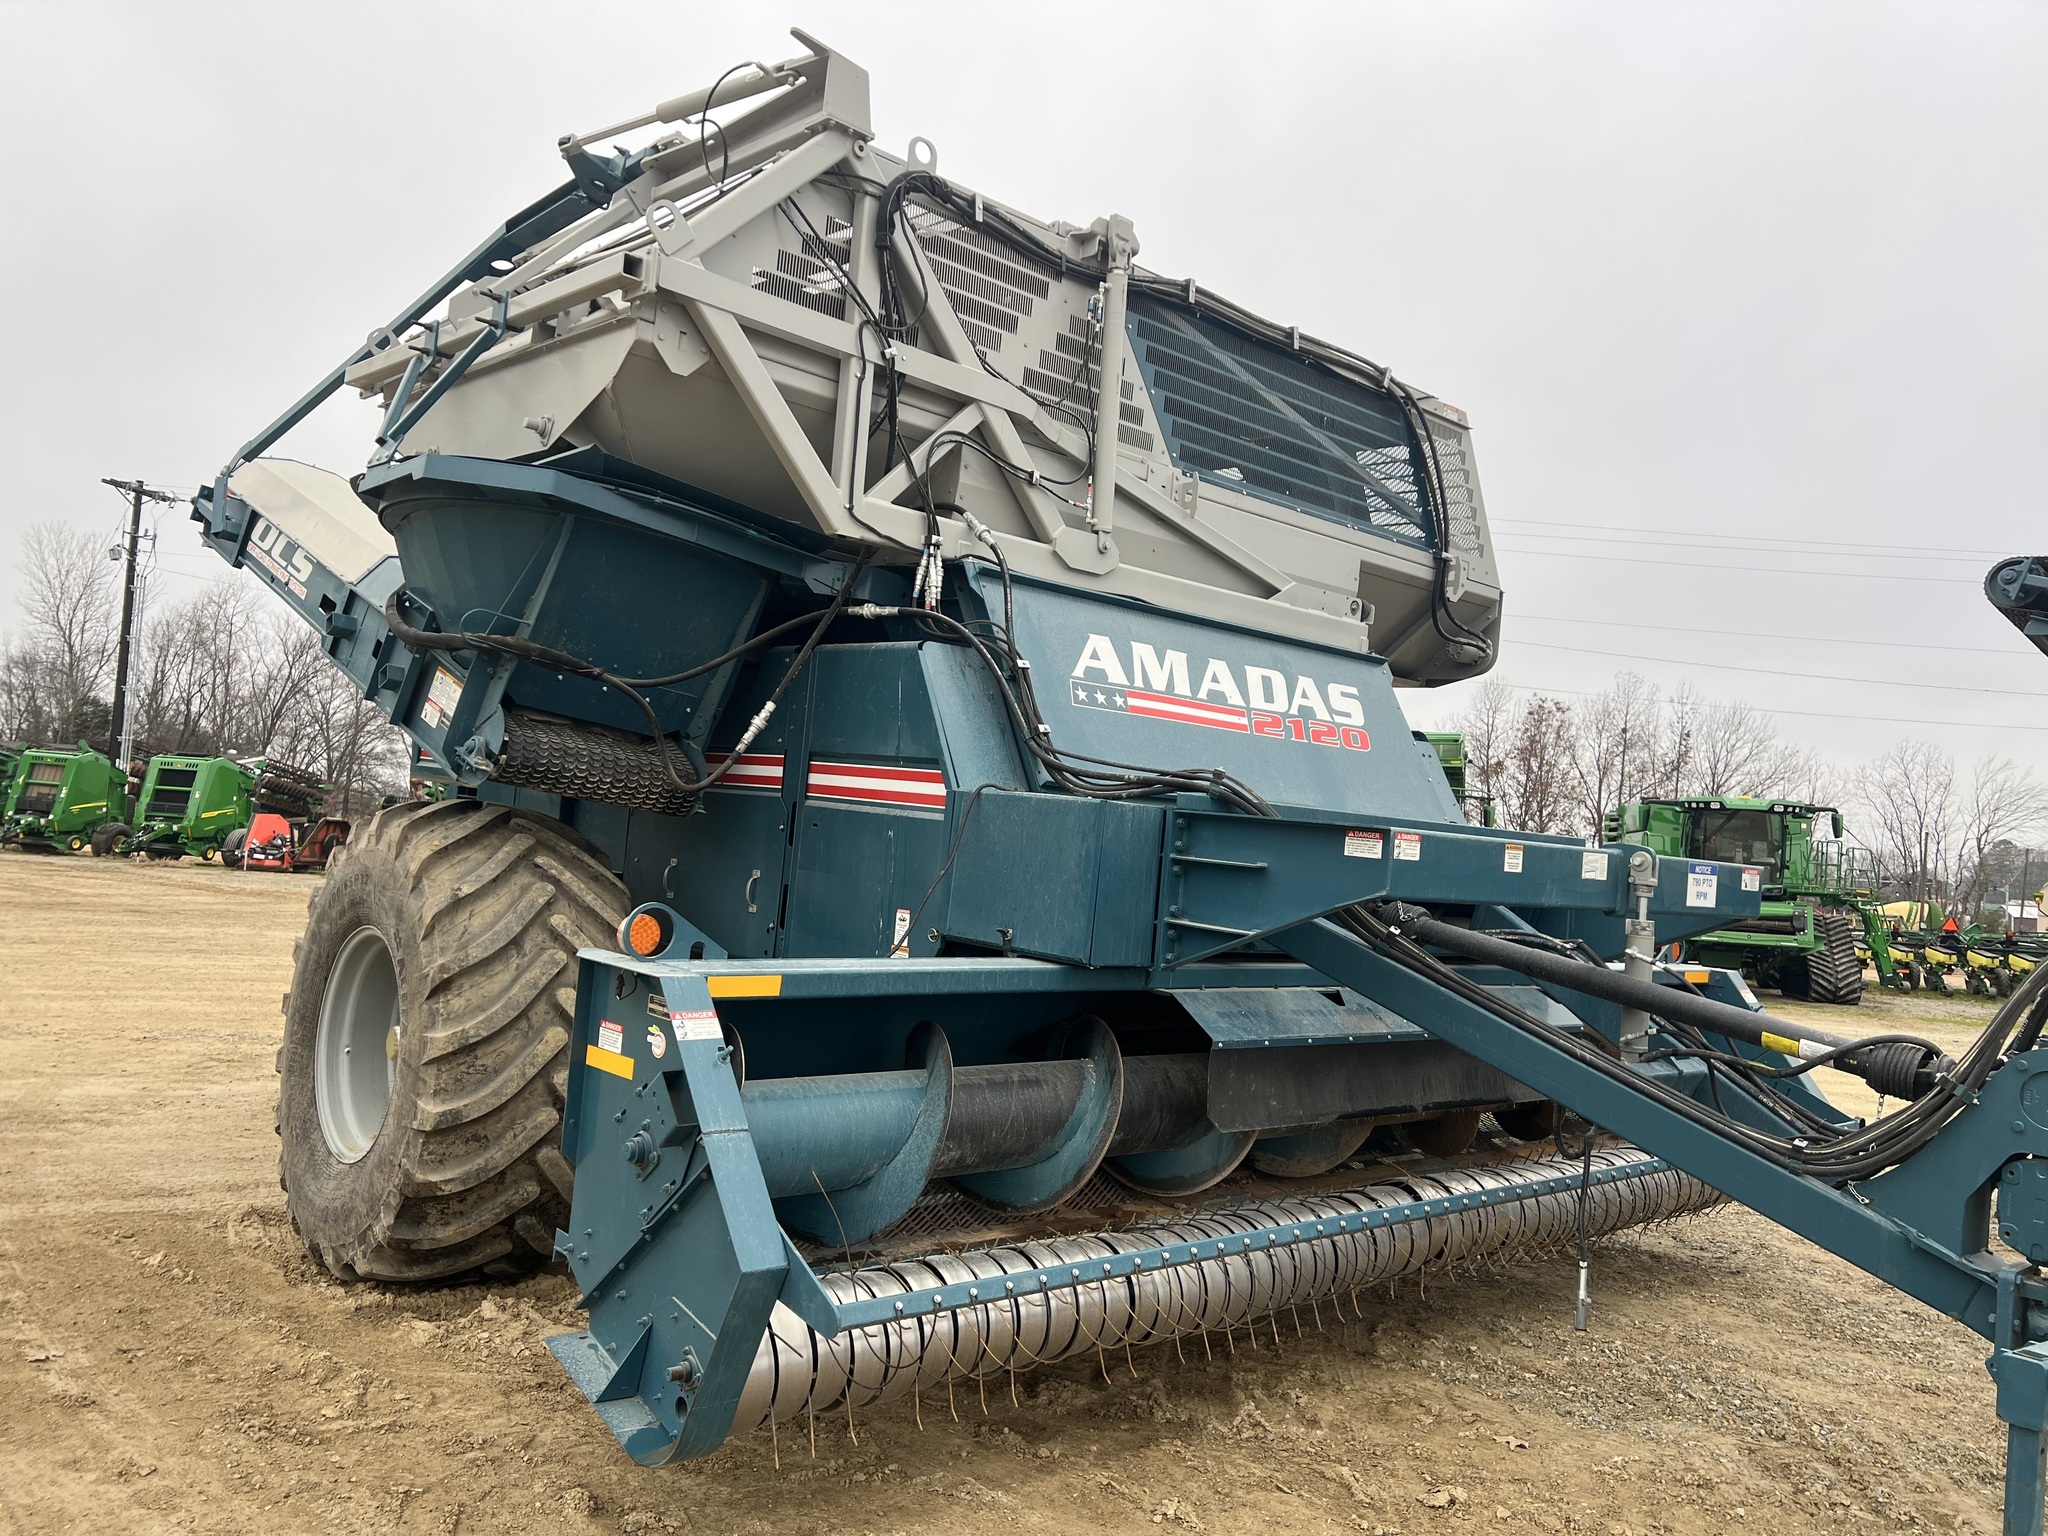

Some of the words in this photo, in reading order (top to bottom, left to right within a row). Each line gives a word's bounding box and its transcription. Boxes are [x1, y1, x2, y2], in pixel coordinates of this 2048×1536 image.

[250, 517, 318, 583] OCS
[1071, 633, 1366, 727] AMADAS
[1251, 711, 1372, 753] 2120
[1354, 830, 1380, 839] DANGER
[1401, 833, 1419, 841] DANGER
[1695, 865, 1712, 875] NOTICE
[1692, 877, 1701, 887] 790
[1702, 878, 1713, 888] PTO
[1696, 891, 1708, 900] RPM
[682, 1011, 714, 1019] DANGER
[605, 1021, 622, 1033] DANGER
